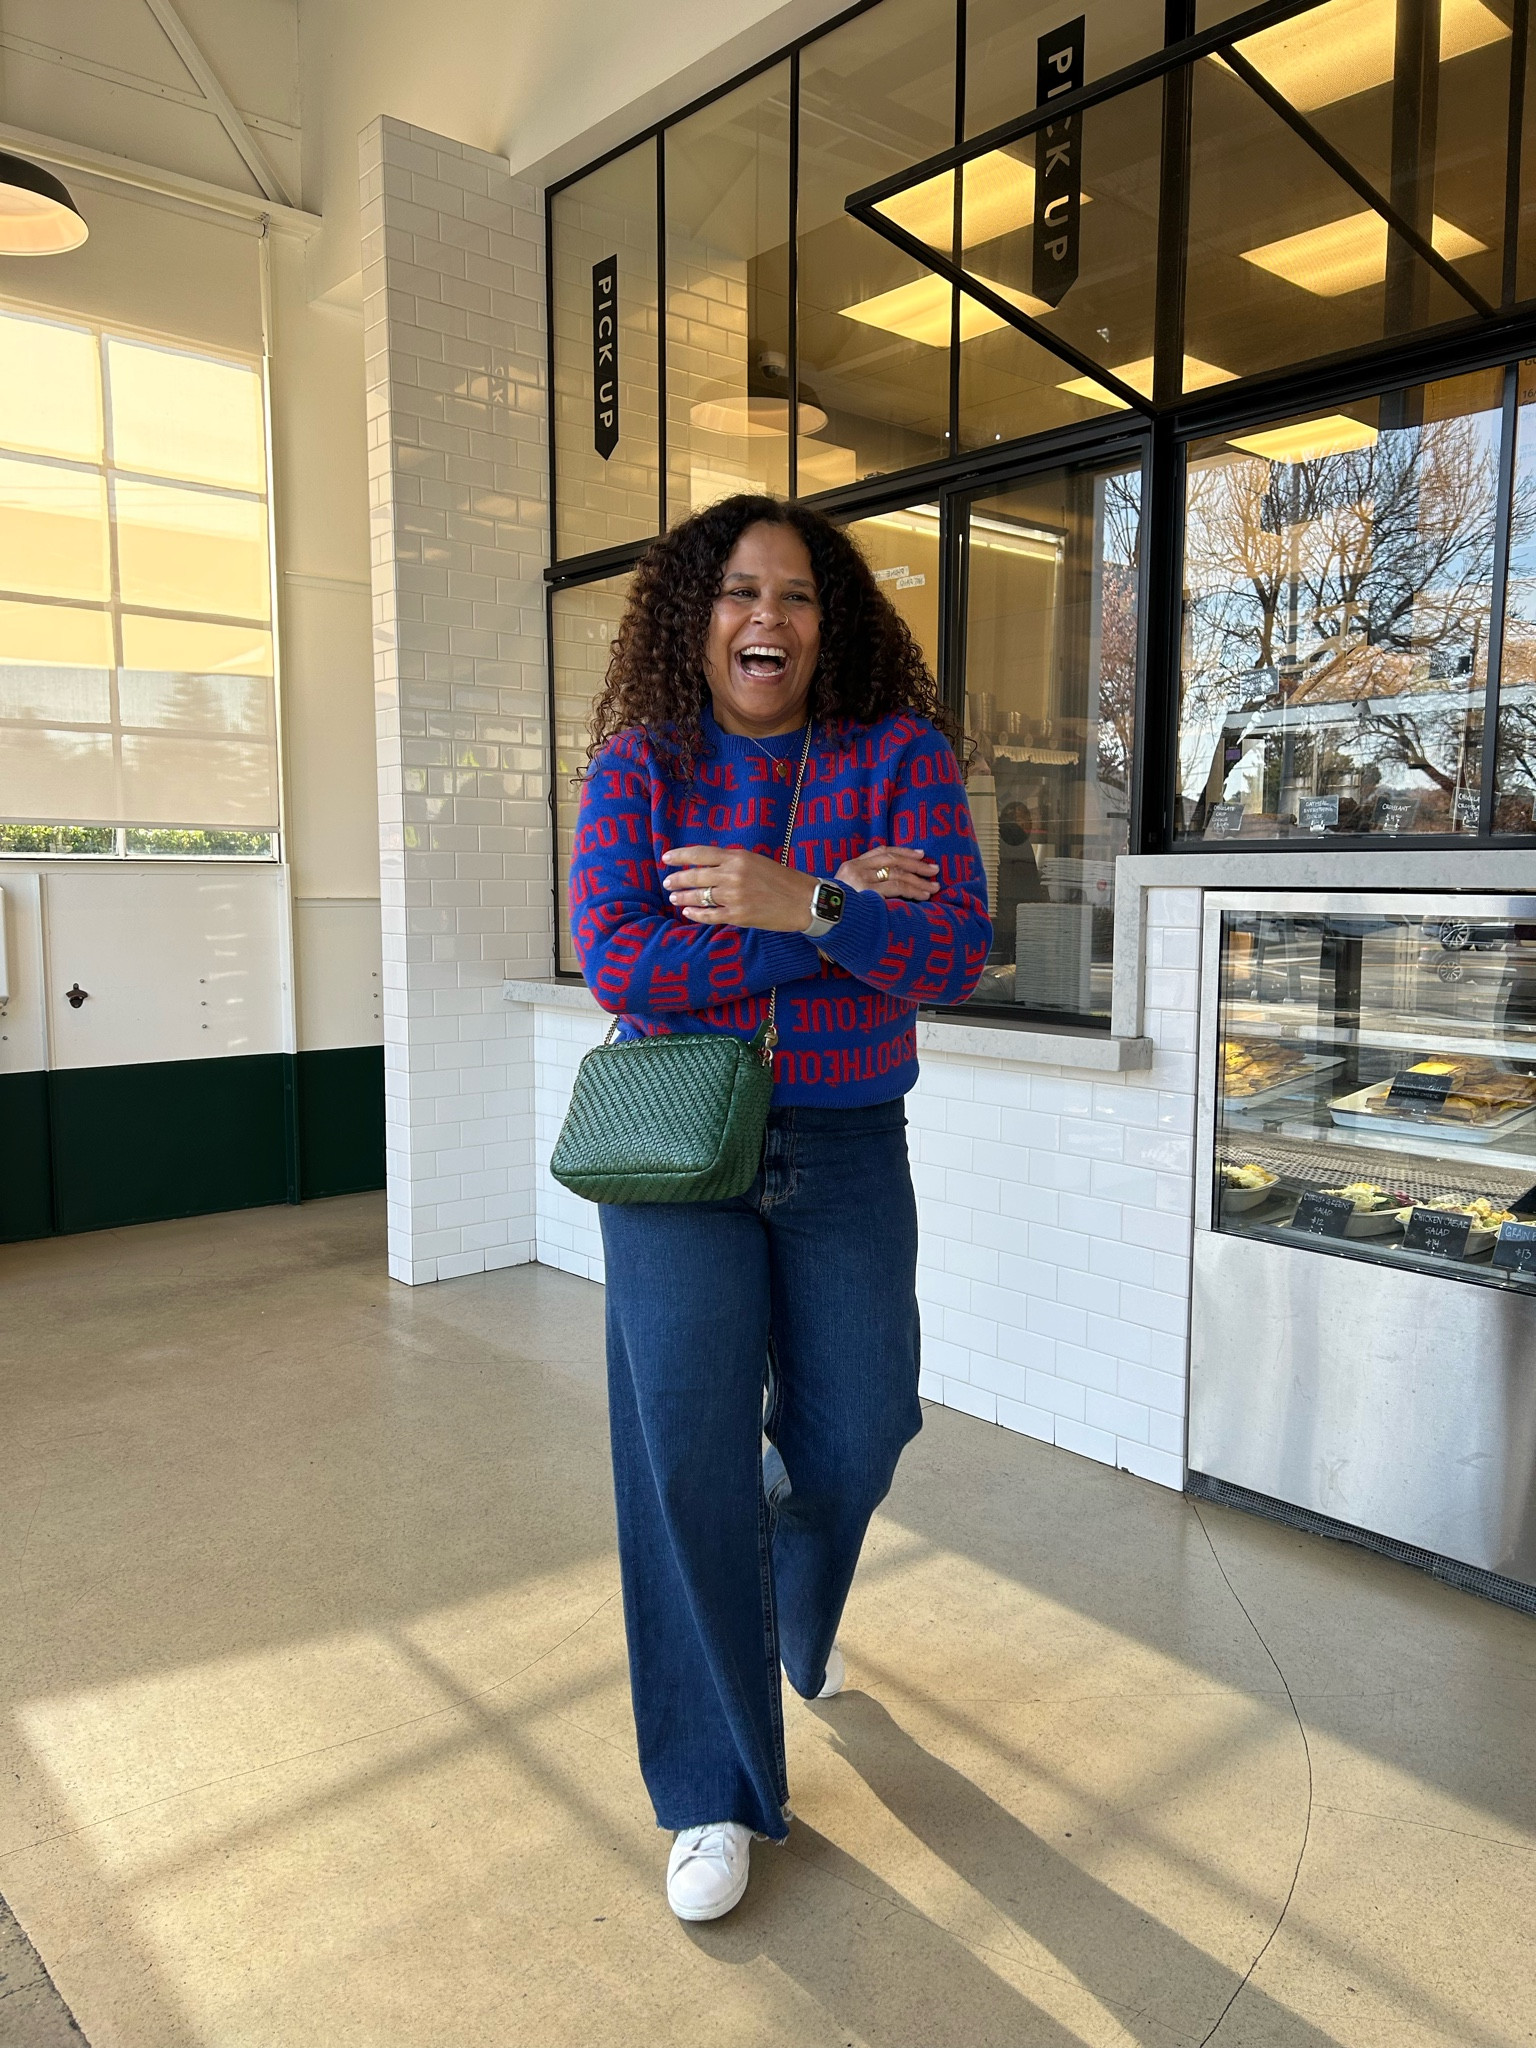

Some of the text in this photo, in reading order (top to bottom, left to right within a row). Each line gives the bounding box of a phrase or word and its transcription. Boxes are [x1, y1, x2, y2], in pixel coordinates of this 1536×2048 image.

[1044, 194, 1069, 261] UP
[598, 275, 613, 428] PICK UP
[1425, 1226, 1450, 1237] SALAD
[1505, 1225, 1531, 1241] GRAIN
